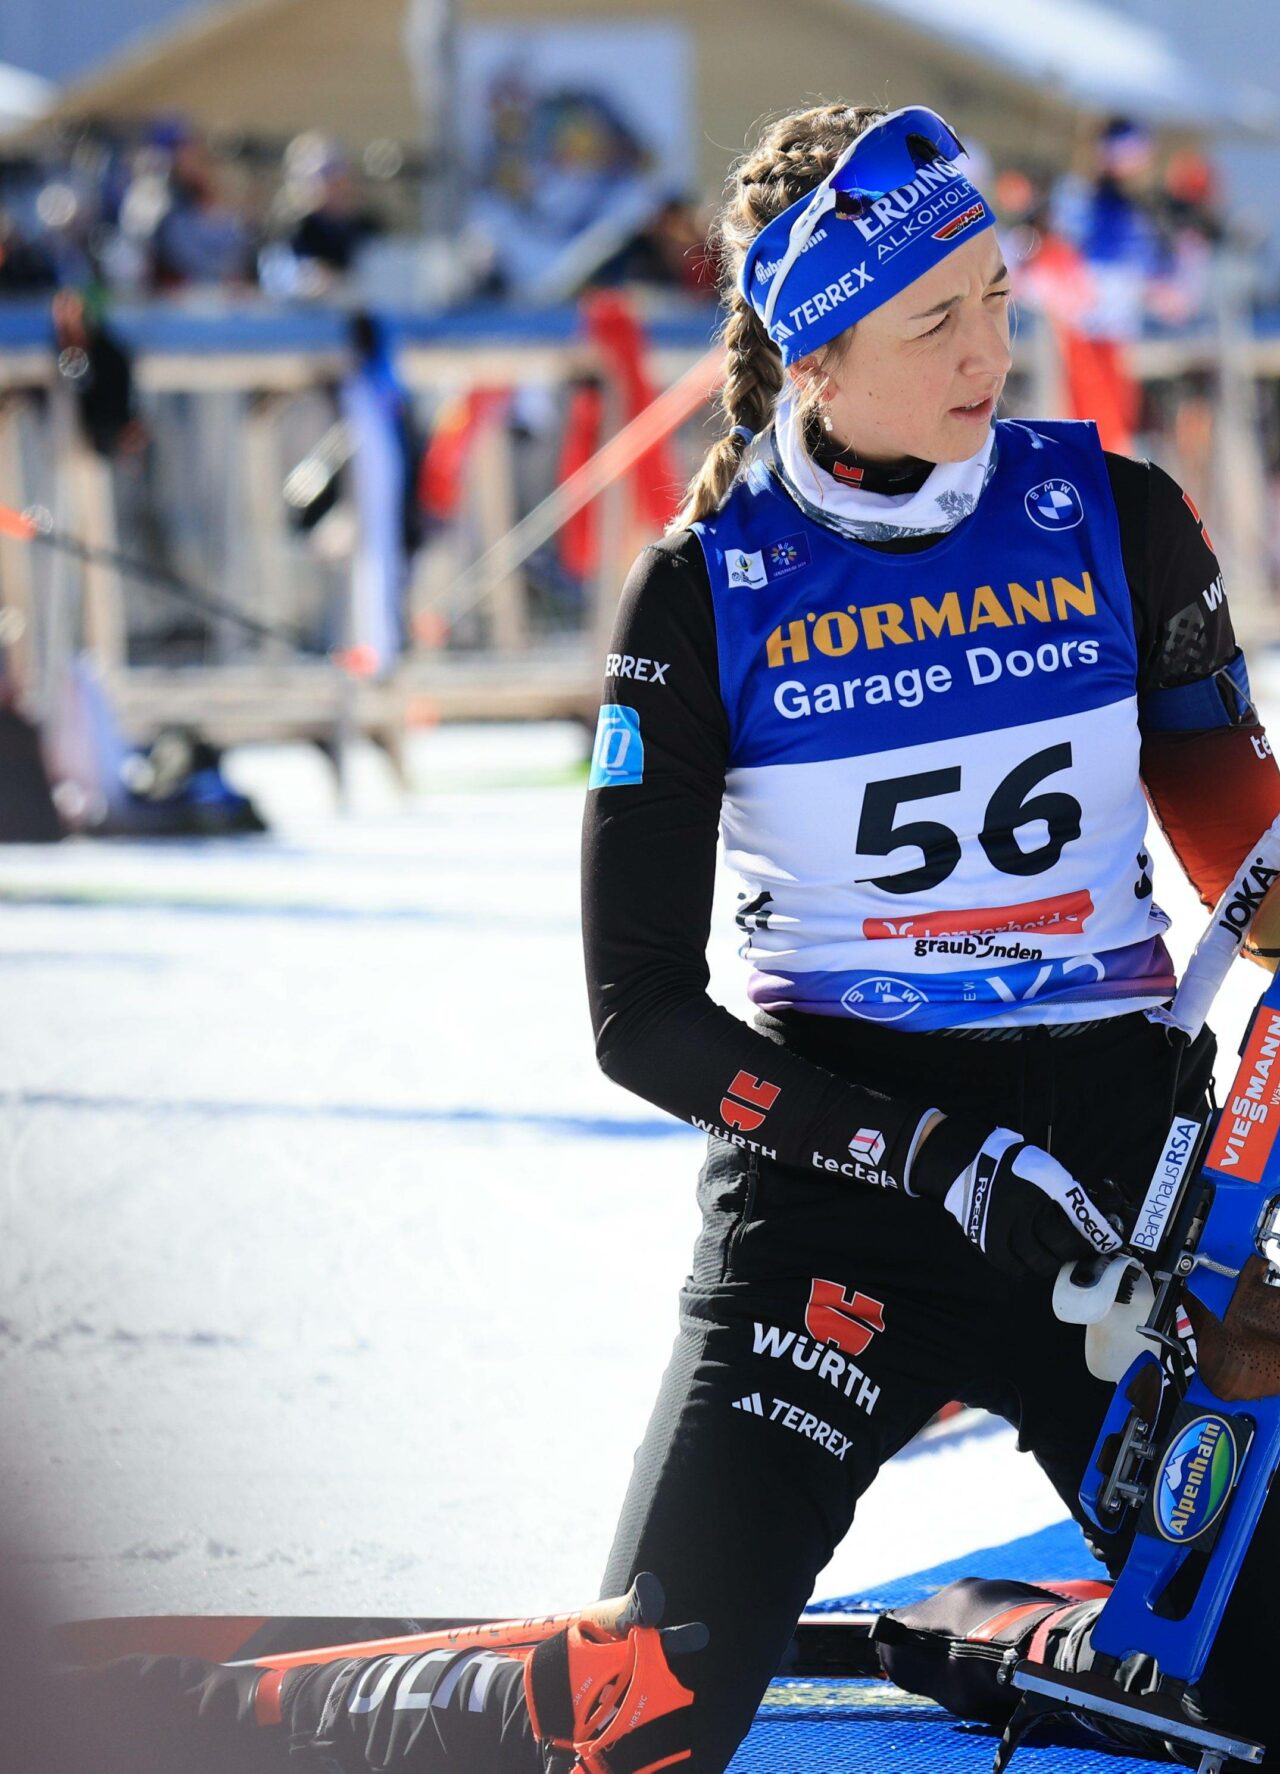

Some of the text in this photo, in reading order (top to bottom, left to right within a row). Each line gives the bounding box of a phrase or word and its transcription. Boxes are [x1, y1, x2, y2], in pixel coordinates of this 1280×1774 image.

[789, 260, 875, 331] TERREX
[1029, 481, 1071, 501] BMW
[766, 572, 1096, 668] HÖRMANN
[773, 638, 1100, 720] Garage Doors
[854, 741, 1082, 895] 56
[848, 981, 920, 1003] BMW
[691, 1114, 777, 1161] WÜRTH
[752, 1322, 881, 1416] WÜRTH
[769, 1397, 853, 1461] TERREX
[1169, 1422, 1221, 1536] Alpenhain
